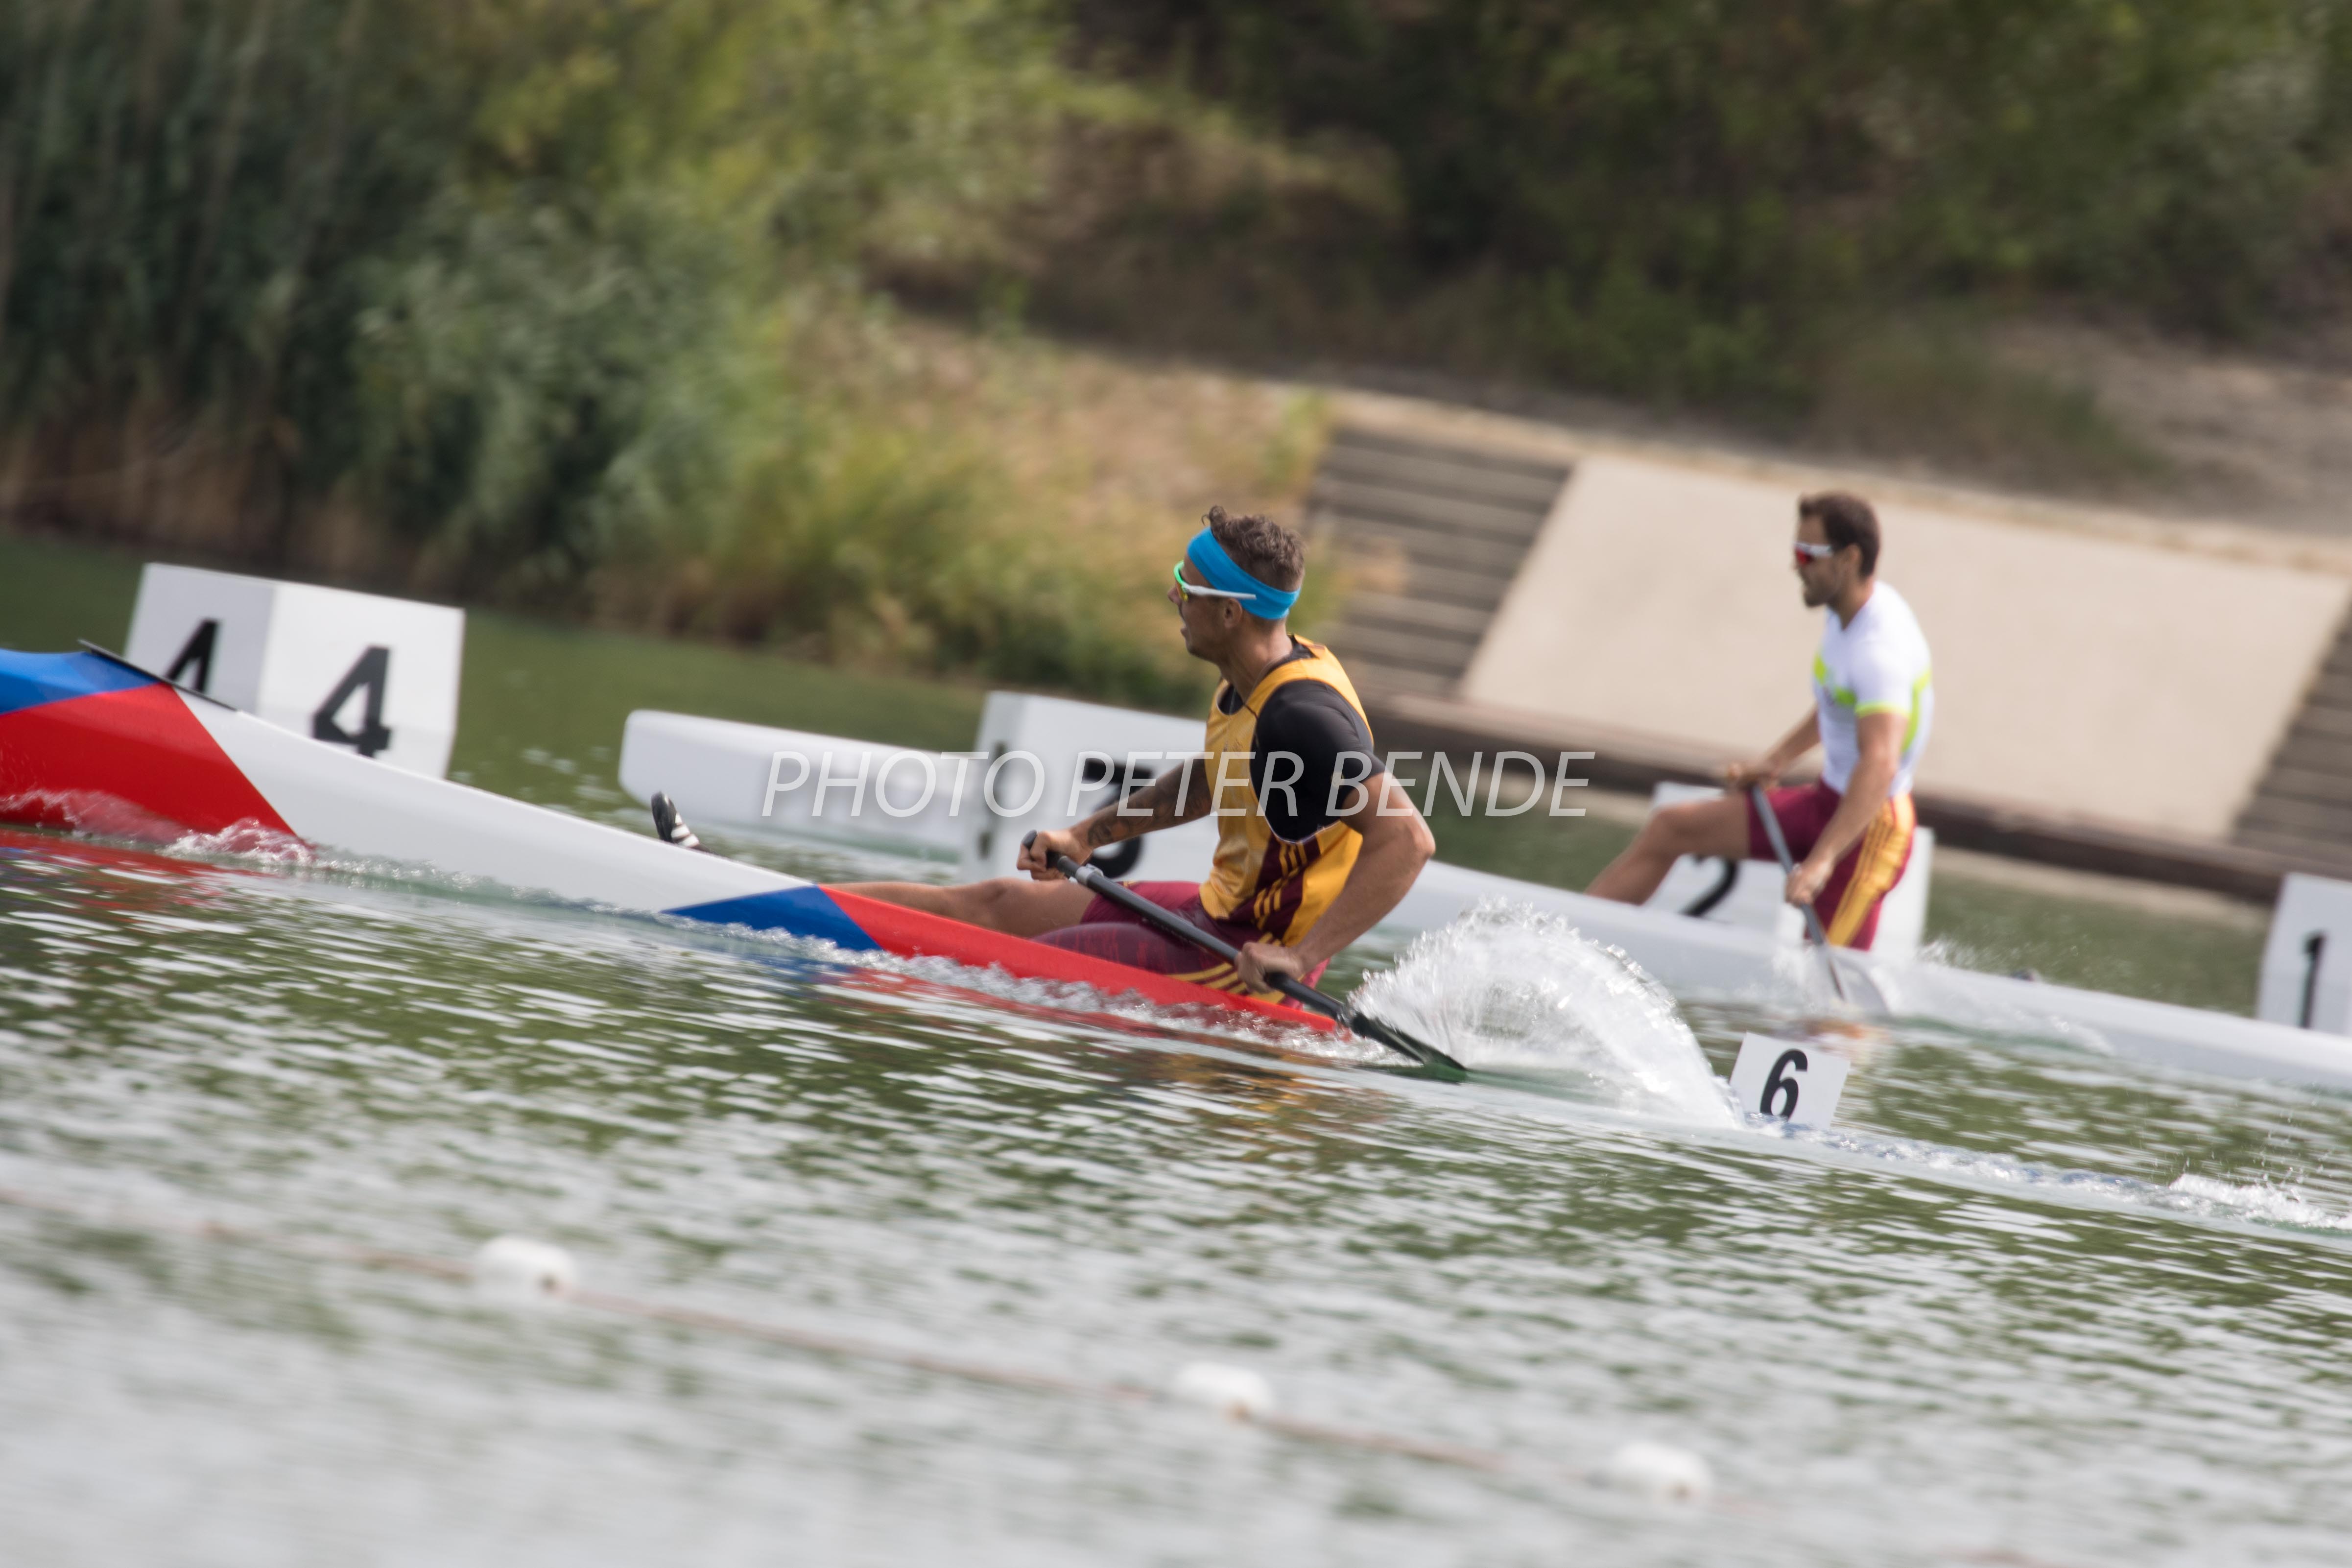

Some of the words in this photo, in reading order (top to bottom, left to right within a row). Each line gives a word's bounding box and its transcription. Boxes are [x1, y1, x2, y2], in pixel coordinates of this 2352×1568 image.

[311, 644, 393, 759] 4
[2300, 929, 2329, 1029] 1
[1759, 1048, 1808, 1122] 6
